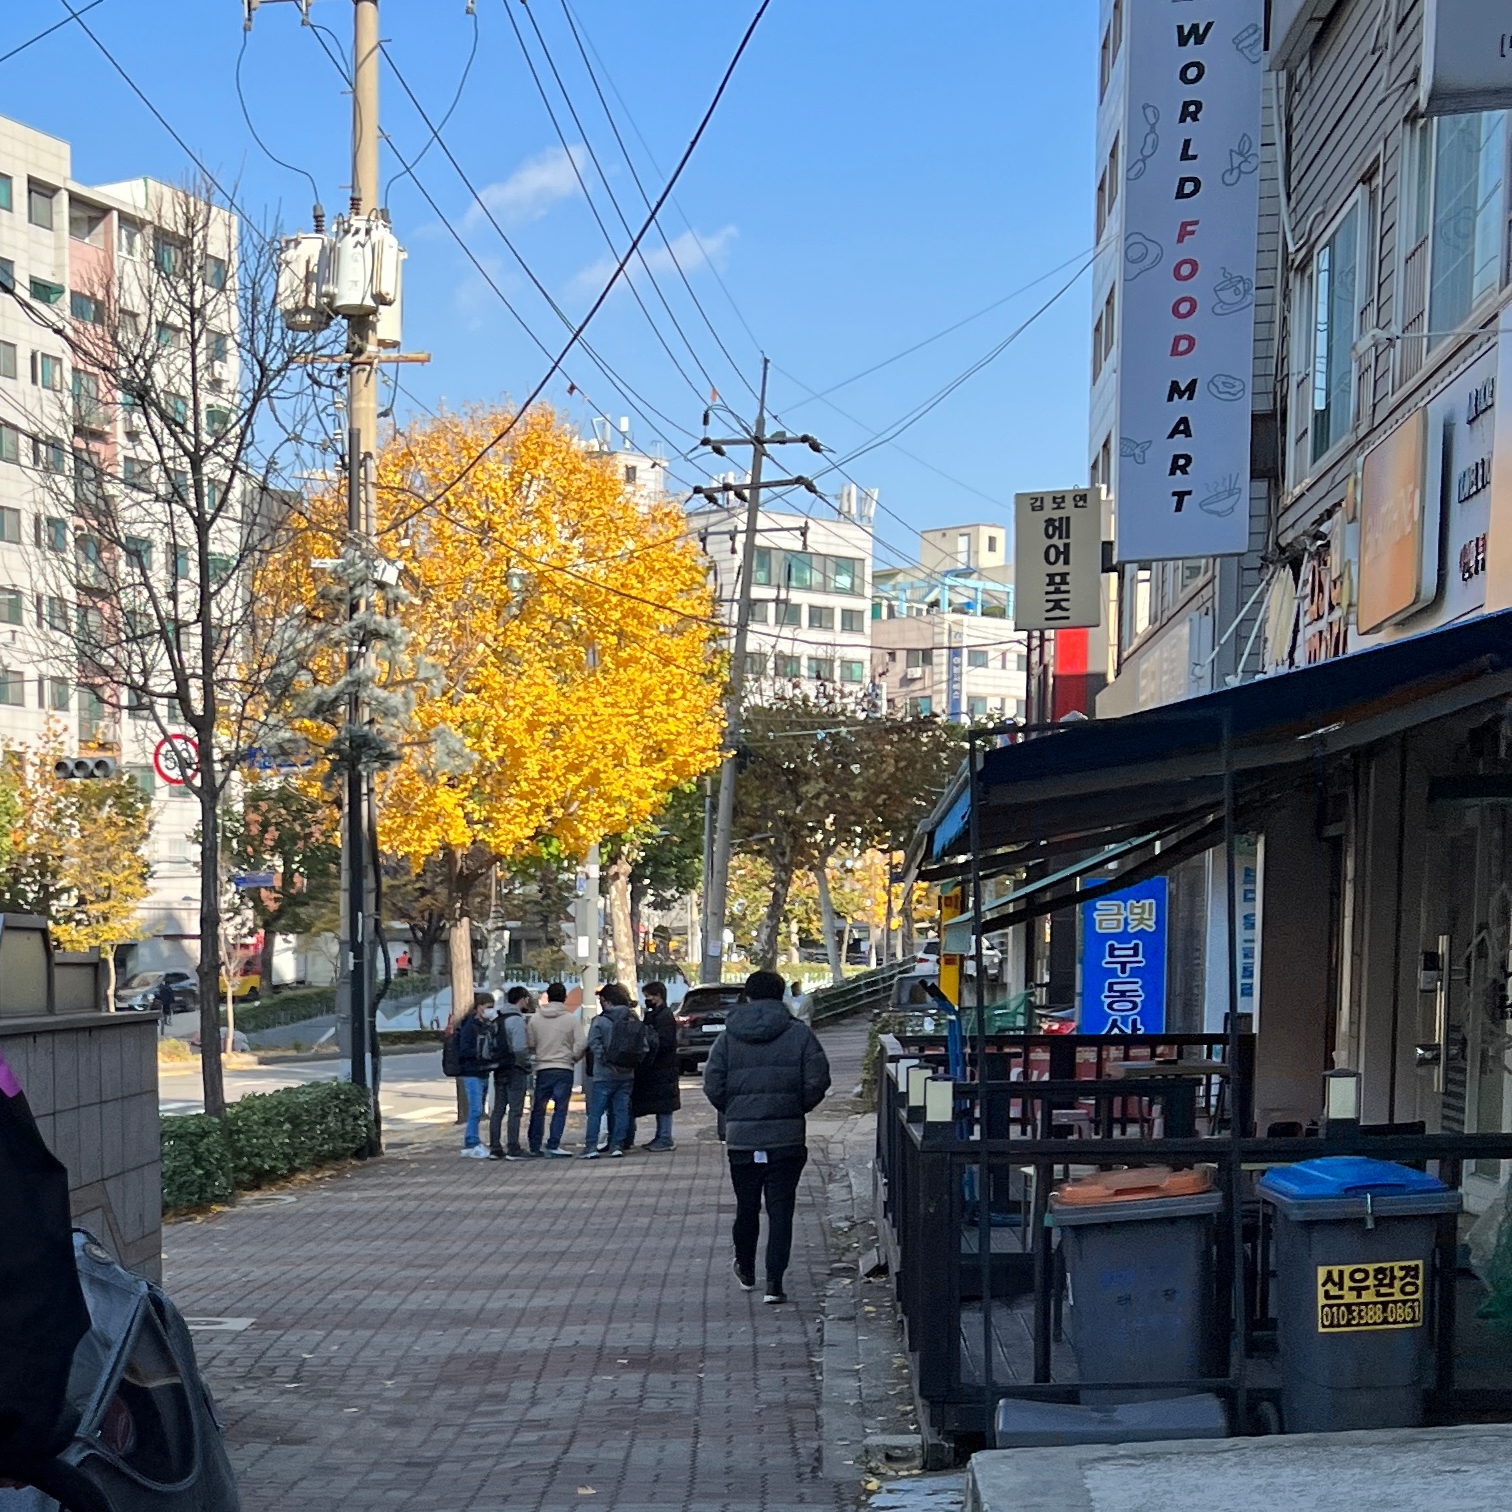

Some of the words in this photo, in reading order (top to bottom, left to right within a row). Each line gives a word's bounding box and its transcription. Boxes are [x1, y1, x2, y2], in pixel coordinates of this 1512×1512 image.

[1174, 21, 1215, 200] WORLD
[1170, 219, 1200, 357] FOOD
[1166, 378, 1198, 513] MART
[1029, 493, 1088, 512] 김보연
[1044, 516, 1070, 621] 헤어포즈
[1093, 899, 1156, 933] 금빛
[1321, 1264, 1419, 1300] 신우환경
[1322, 1301, 1419, 1326] 010-3388-0861
